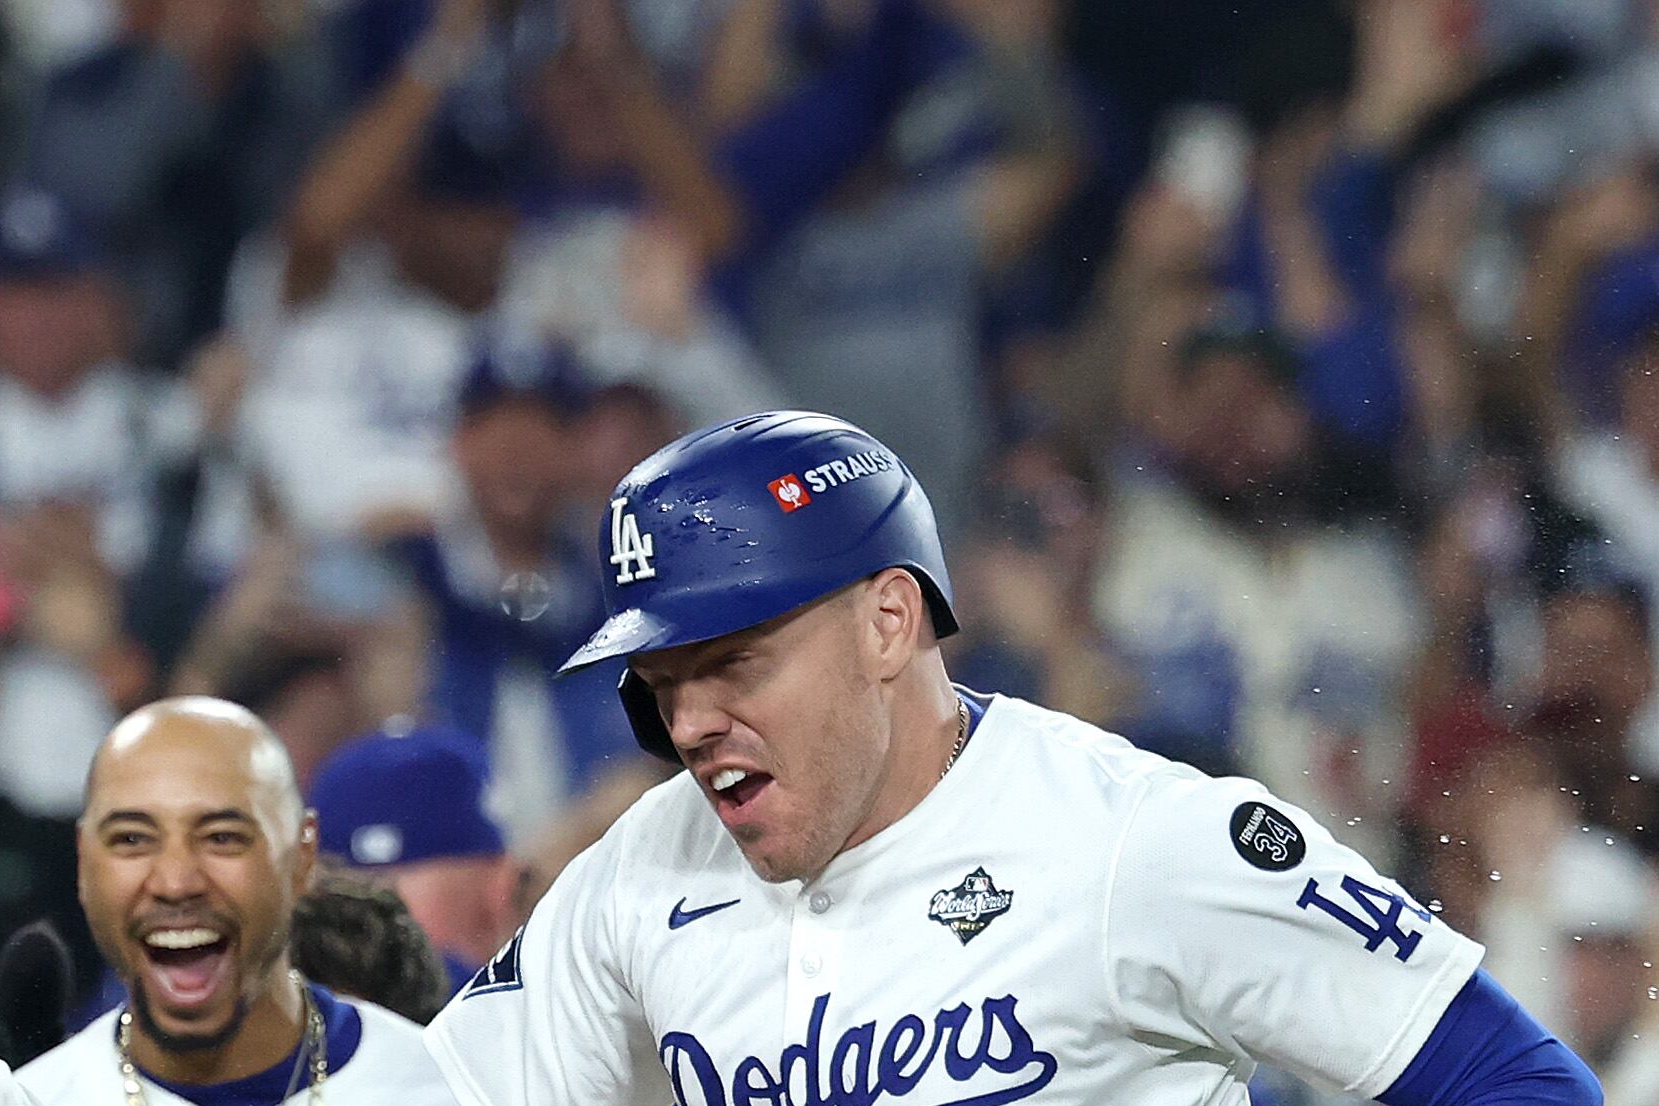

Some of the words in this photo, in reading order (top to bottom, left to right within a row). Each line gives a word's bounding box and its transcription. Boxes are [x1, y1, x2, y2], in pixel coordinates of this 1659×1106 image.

[804, 450, 895, 493] STRAUSS
[609, 497, 656, 584] LA
[1253, 815, 1298, 863] 34
